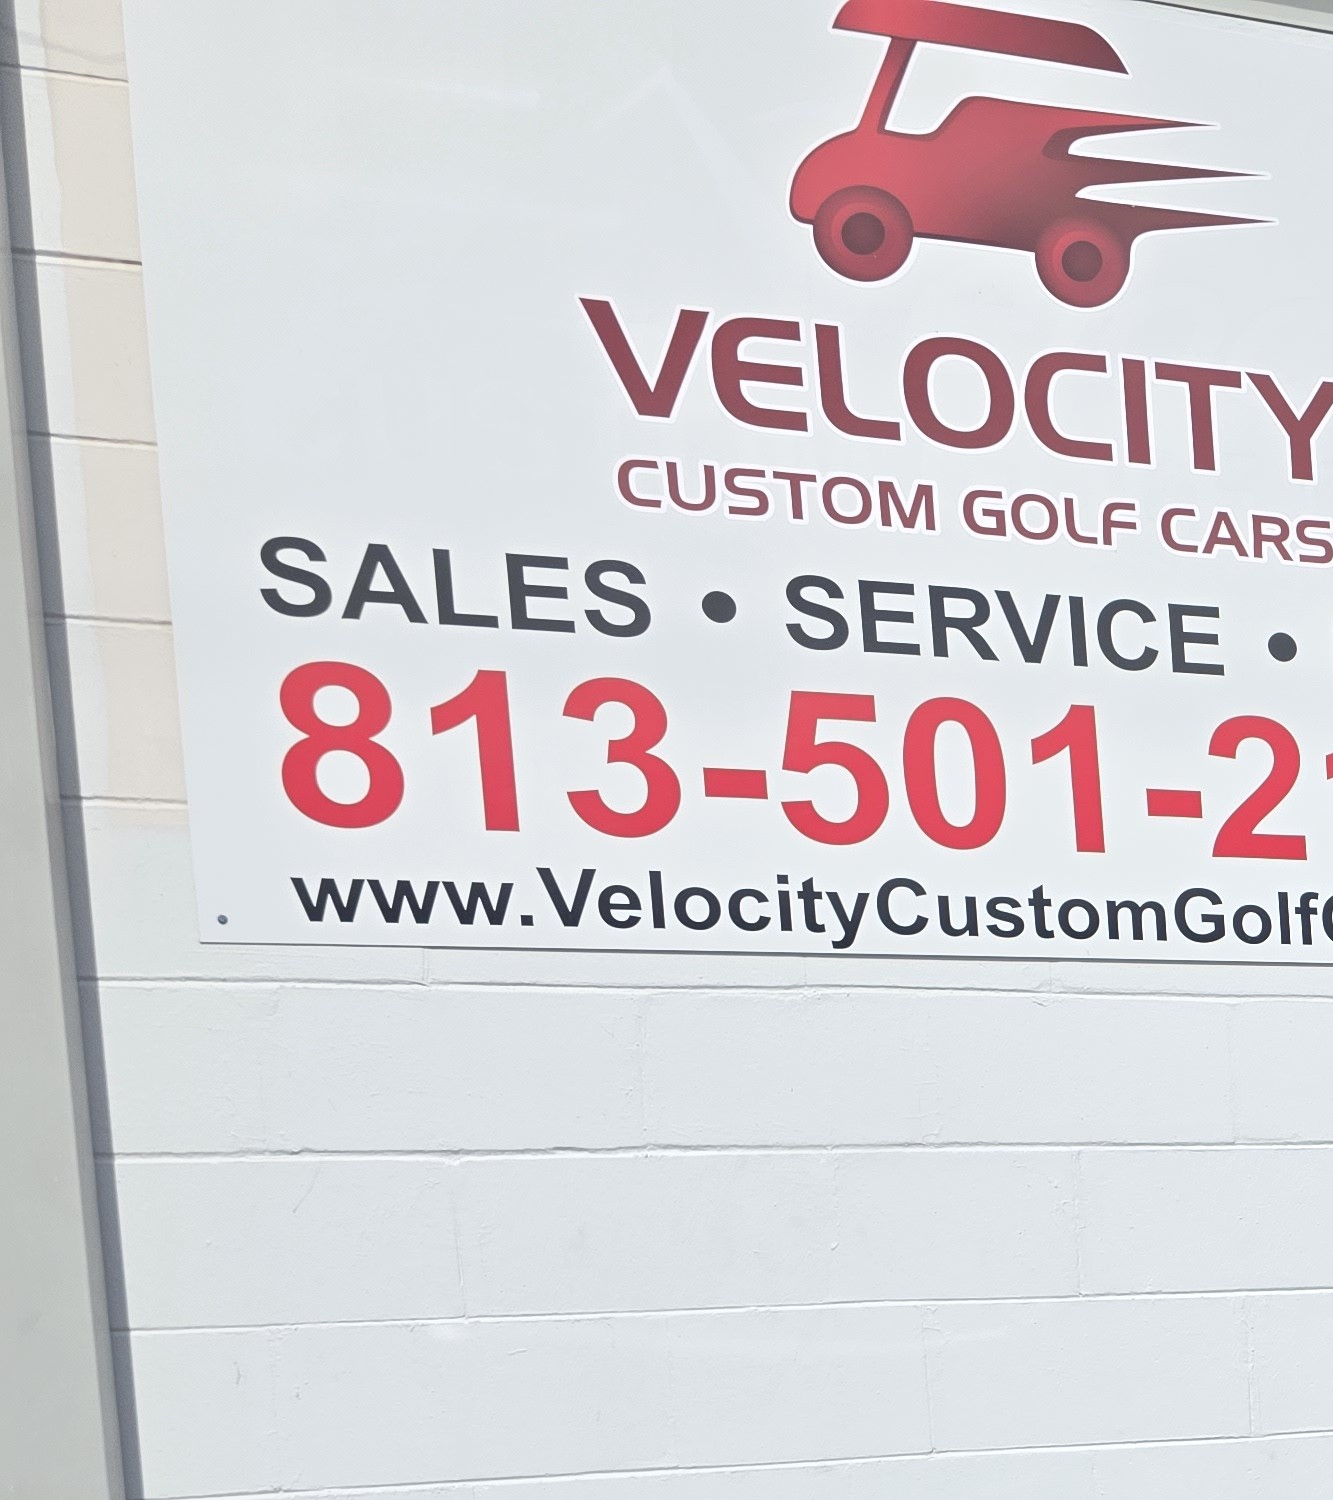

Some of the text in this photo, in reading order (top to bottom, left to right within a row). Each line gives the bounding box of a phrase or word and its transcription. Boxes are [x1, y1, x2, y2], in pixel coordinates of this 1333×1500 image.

[616, 458, 937, 532] CUSTOM
[961, 488, 1138, 547] GOLF
[258, 535, 653, 639] SALES
[784, 573, 1226, 678] SERVICE
